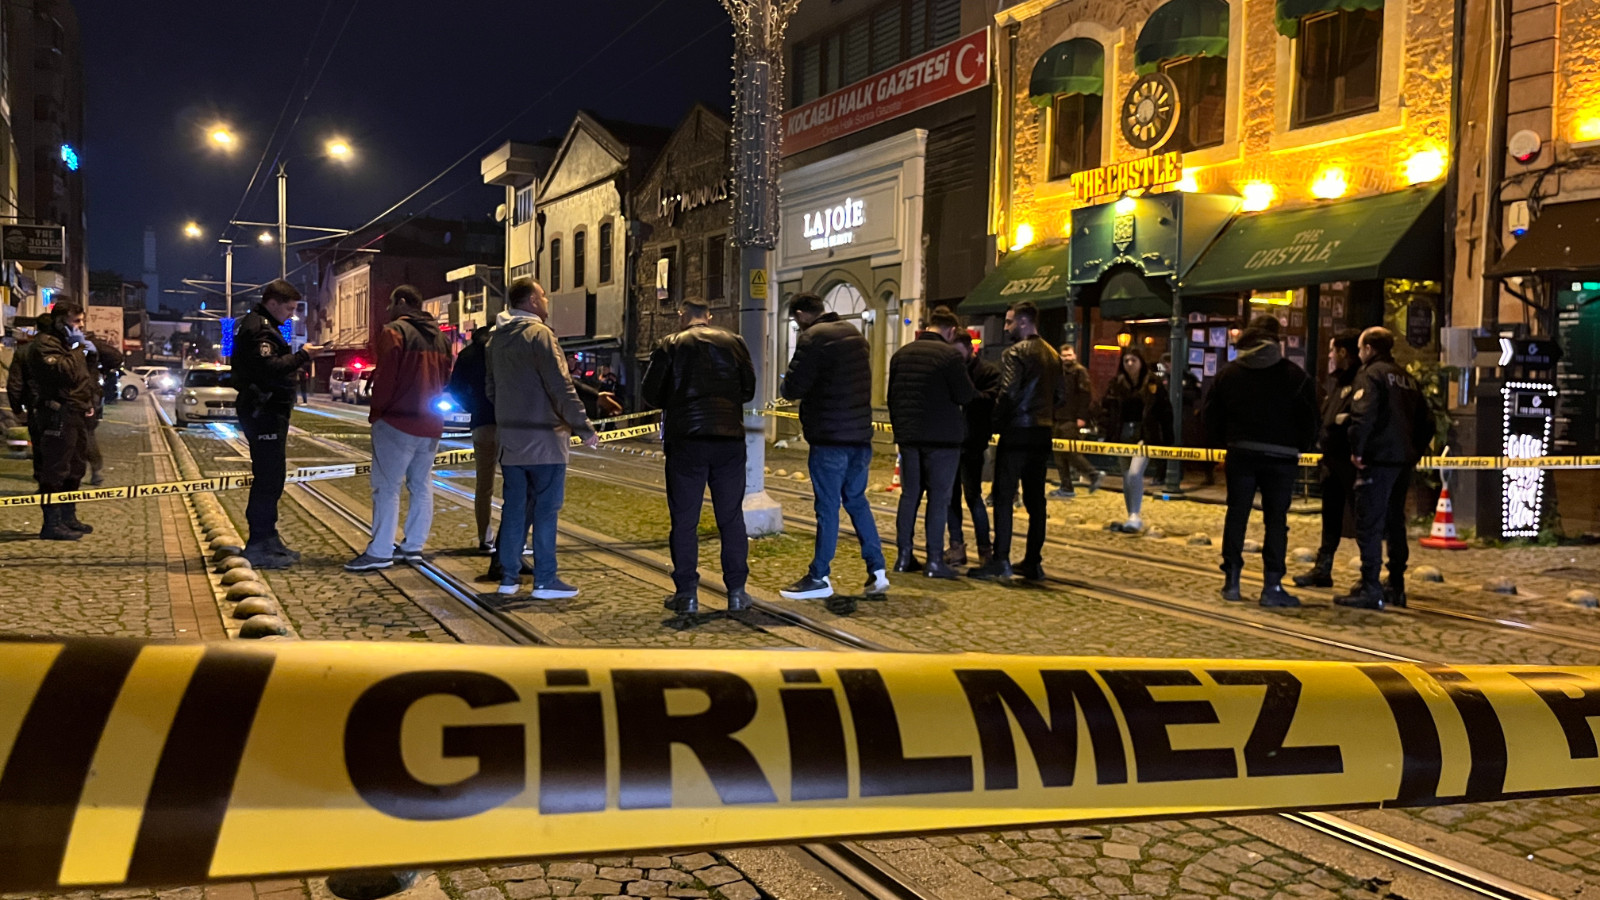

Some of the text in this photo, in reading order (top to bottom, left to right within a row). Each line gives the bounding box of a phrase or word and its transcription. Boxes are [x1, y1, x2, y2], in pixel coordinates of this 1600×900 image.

[837, 82, 875, 118] HALK
[876, 50, 951, 102] GAZETESİ
[1069, 150, 1178, 203] THE CASTLE
[1292, 229, 1325, 245] THE
[1244, 240, 1340, 270] CASTLE
[1000, 275, 1060, 296] CASTLE
[598, 432, 625, 441] KAZA
[58, 490, 124, 502] GİRİLMEZ
[140, 479, 215, 495] KAZA YERİ
[3, 496, 36, 505] YERİ
[342, 668, 1344, 822] GİRİLMEZ
